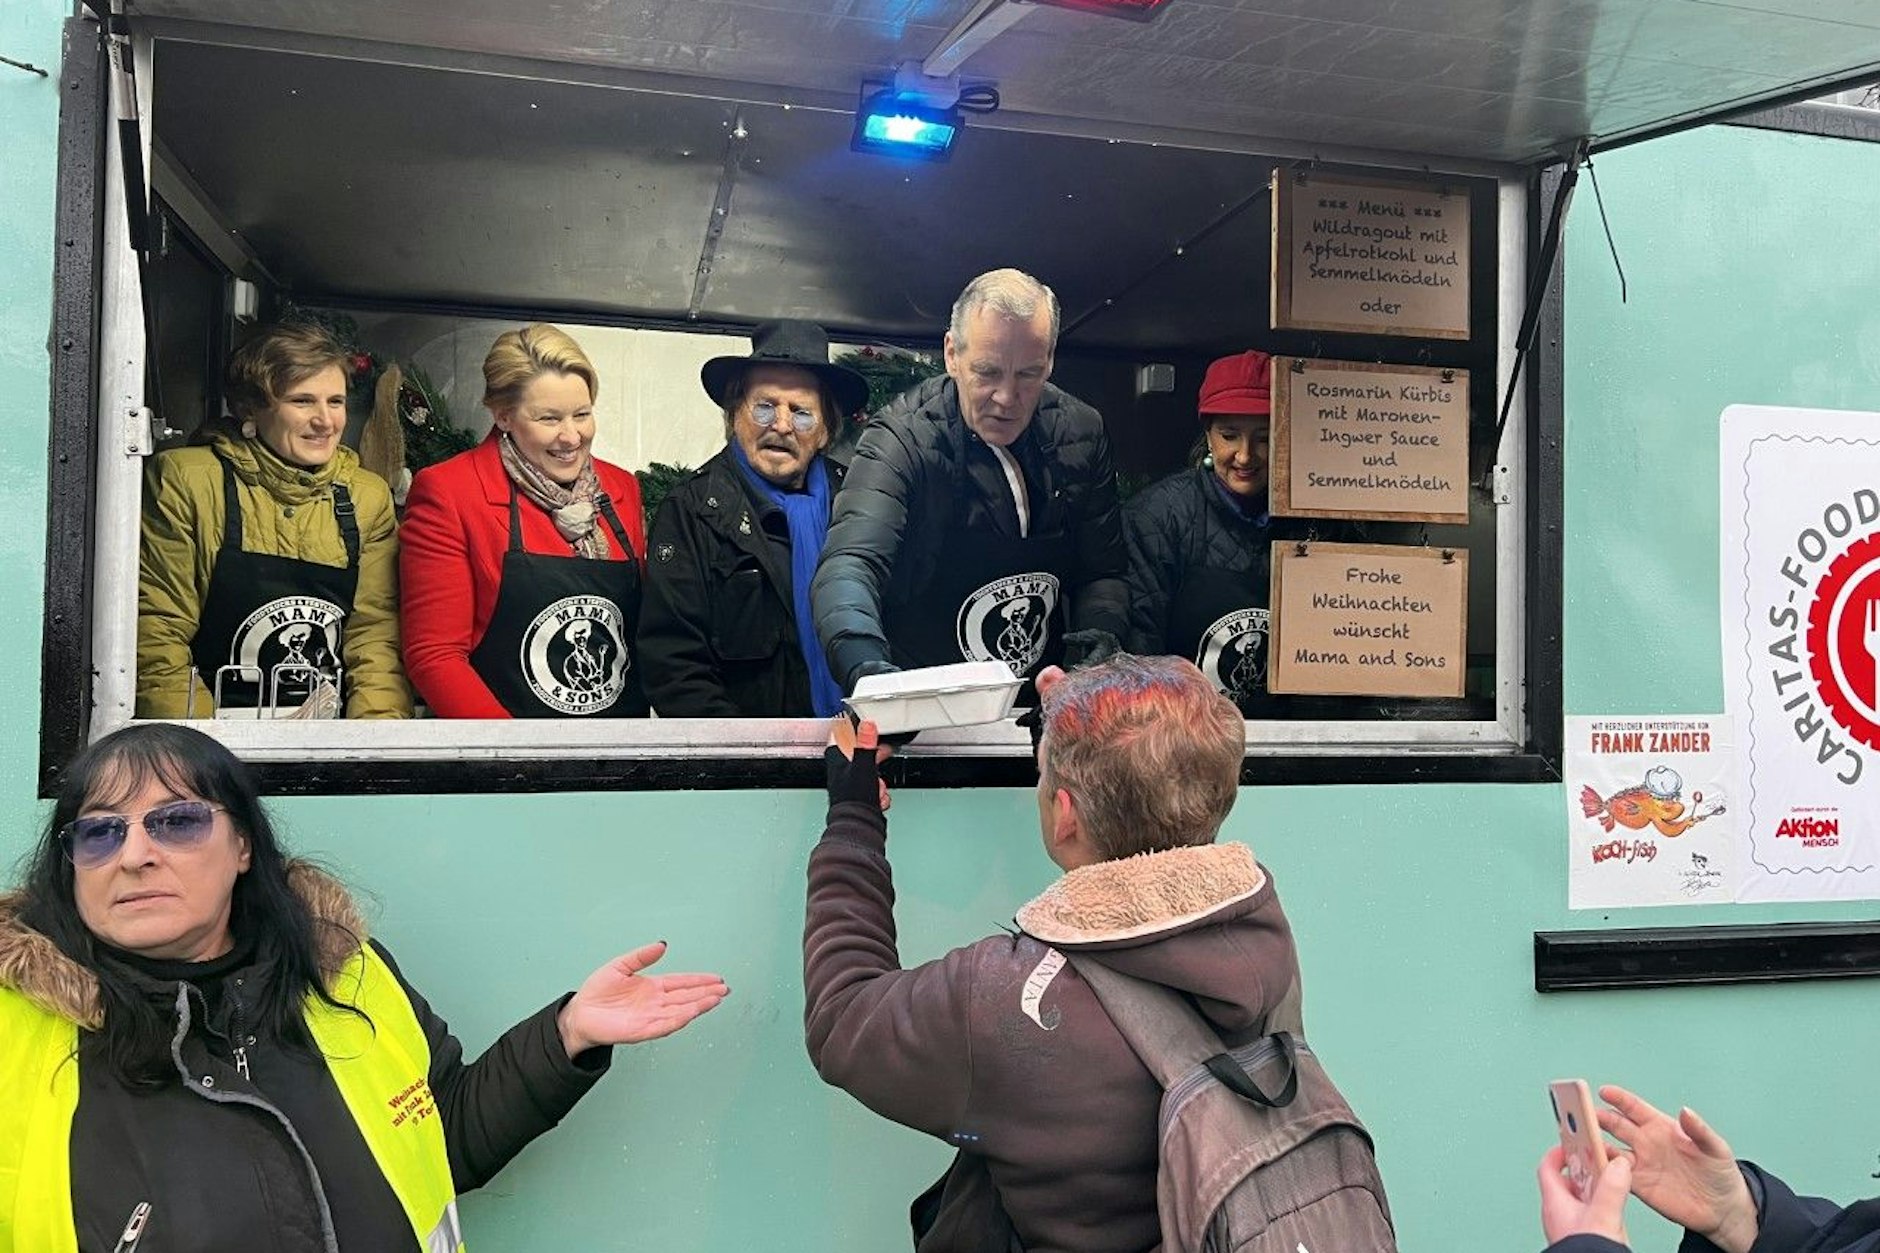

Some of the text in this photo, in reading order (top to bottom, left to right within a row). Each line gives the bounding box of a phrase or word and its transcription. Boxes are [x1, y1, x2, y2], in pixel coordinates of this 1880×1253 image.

[1358, 200, 1406, 217] Menü
[1313, 219, 1448, 243] Wildragout mit
[1303, 239, 1458, 266] Apfelrotkohl und
[1309, 263, 1452, 288] Semmelknödeln
[1360, 297, 1401, 314] oder
[1306, 383, 1452, 403] Rosmarin Kürbis
[1318, 406, 1441, 424] mit Maronen-
[1320, 428, 1440, 448] Ingwer Sauce
[1362, 451, 1398, 466] und
[1308, 472, 1451, 491] Semmelknödeln
[1346, 568, 1402, 584] Frohe
[1313, 593, 1432, 613] Weihnachten
[555, 607, 612, 626] MAMA
[1333, 622, 1410, 640] wünscht
[1295, 649, 1446, 668] Mama and Sons
[566, 684, 613, 703] SONS
[1592, 732, 1710, 753] FRANK ZANDER
[1802, 839, 1838, 847] MENSCH
